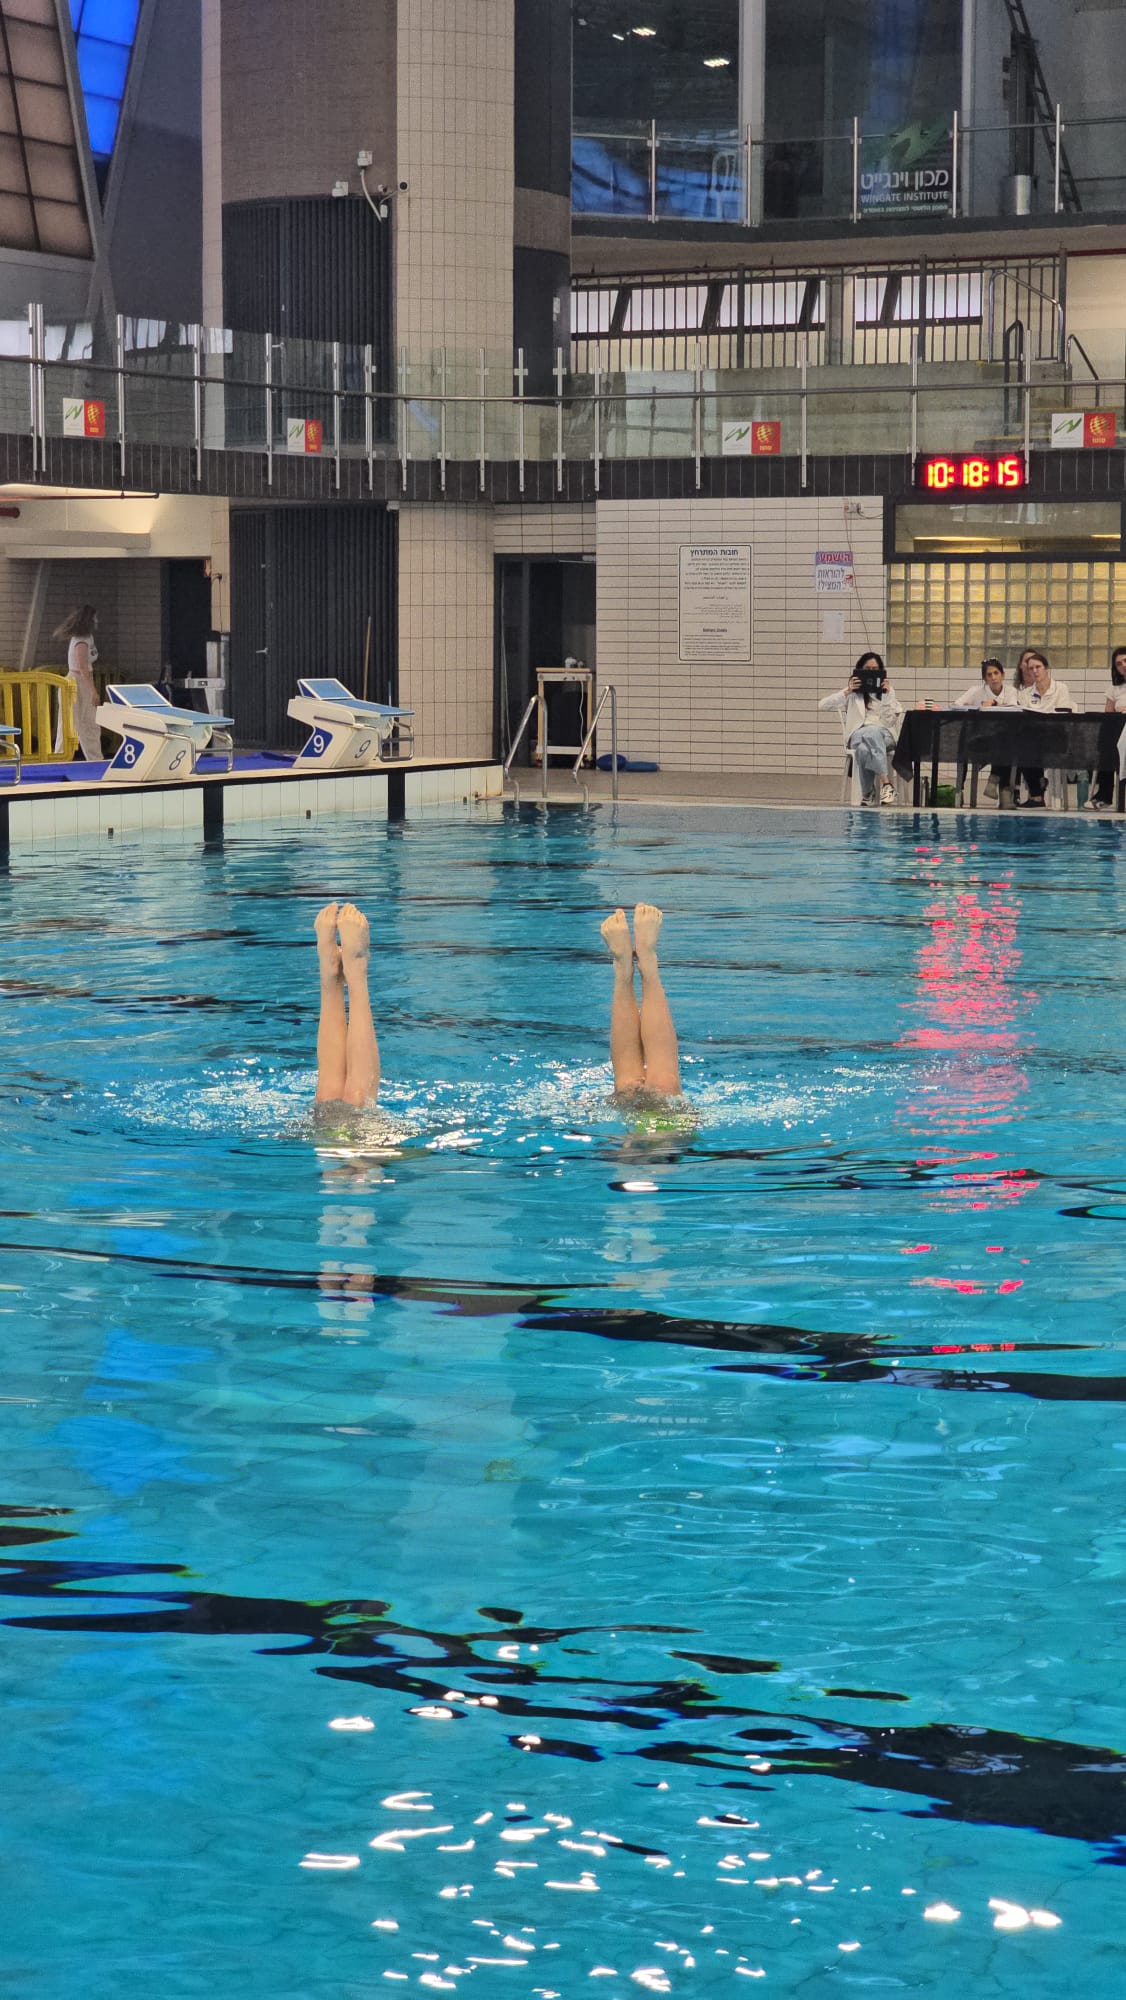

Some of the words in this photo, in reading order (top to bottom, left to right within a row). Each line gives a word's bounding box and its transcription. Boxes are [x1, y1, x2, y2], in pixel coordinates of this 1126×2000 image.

[860, 171, 909, 190] וינגייט
[914, 169, 949, 191] מכון
[860, 192, 902, 204] WINGATE
[903, 190, 949, 202] INSTITUTE
[927, 460, 1019, 488] 10:18:15
[690, 549, 718, 557] המתרחץ
[819, 552, 852, 563] הישמע
[817, 567, 845, 580] להוראות
[312, 734, 325, 754] 9
[354, 740, 371, 759] 9
[124, 744, 136, 764] 8
[168, 750, 186, 770] 8
